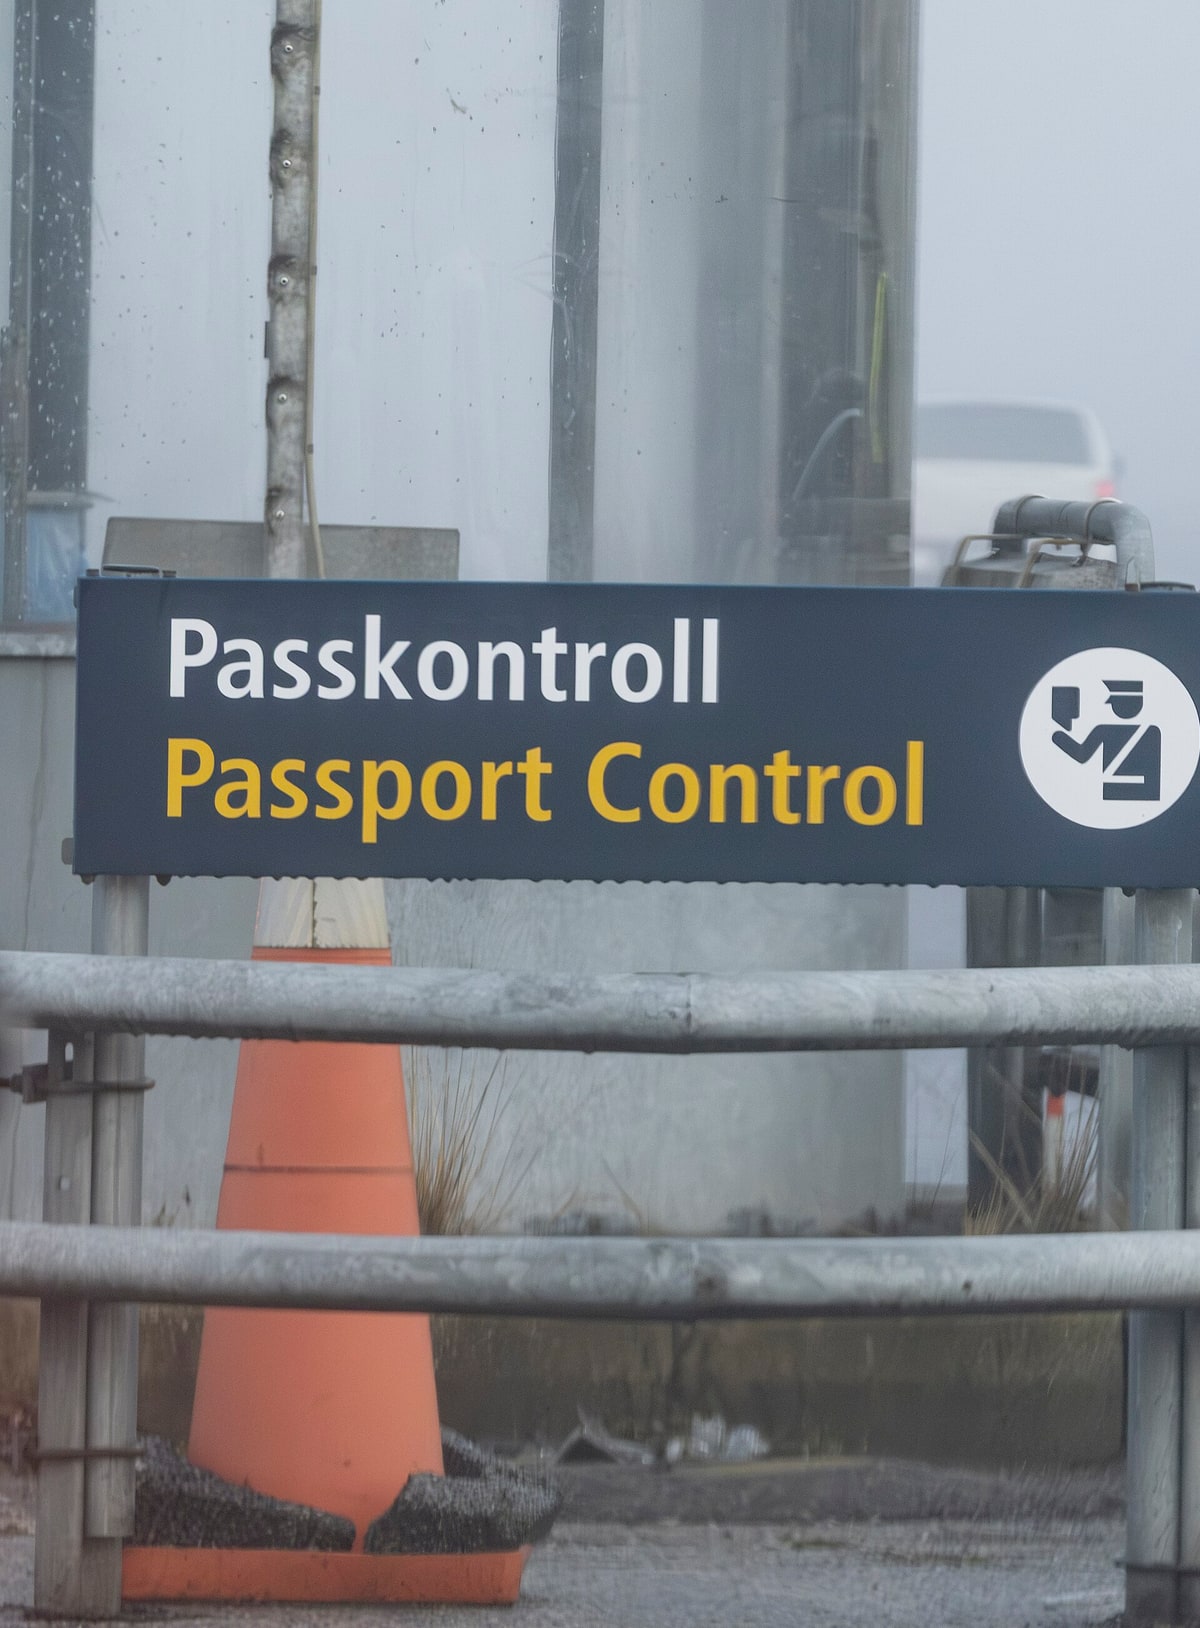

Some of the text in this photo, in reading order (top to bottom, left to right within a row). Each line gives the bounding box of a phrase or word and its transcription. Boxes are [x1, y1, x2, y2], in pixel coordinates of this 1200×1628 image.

[168, 616, 721, 704] Passkontroll
[165, 736, 925, 845] Passport Control
